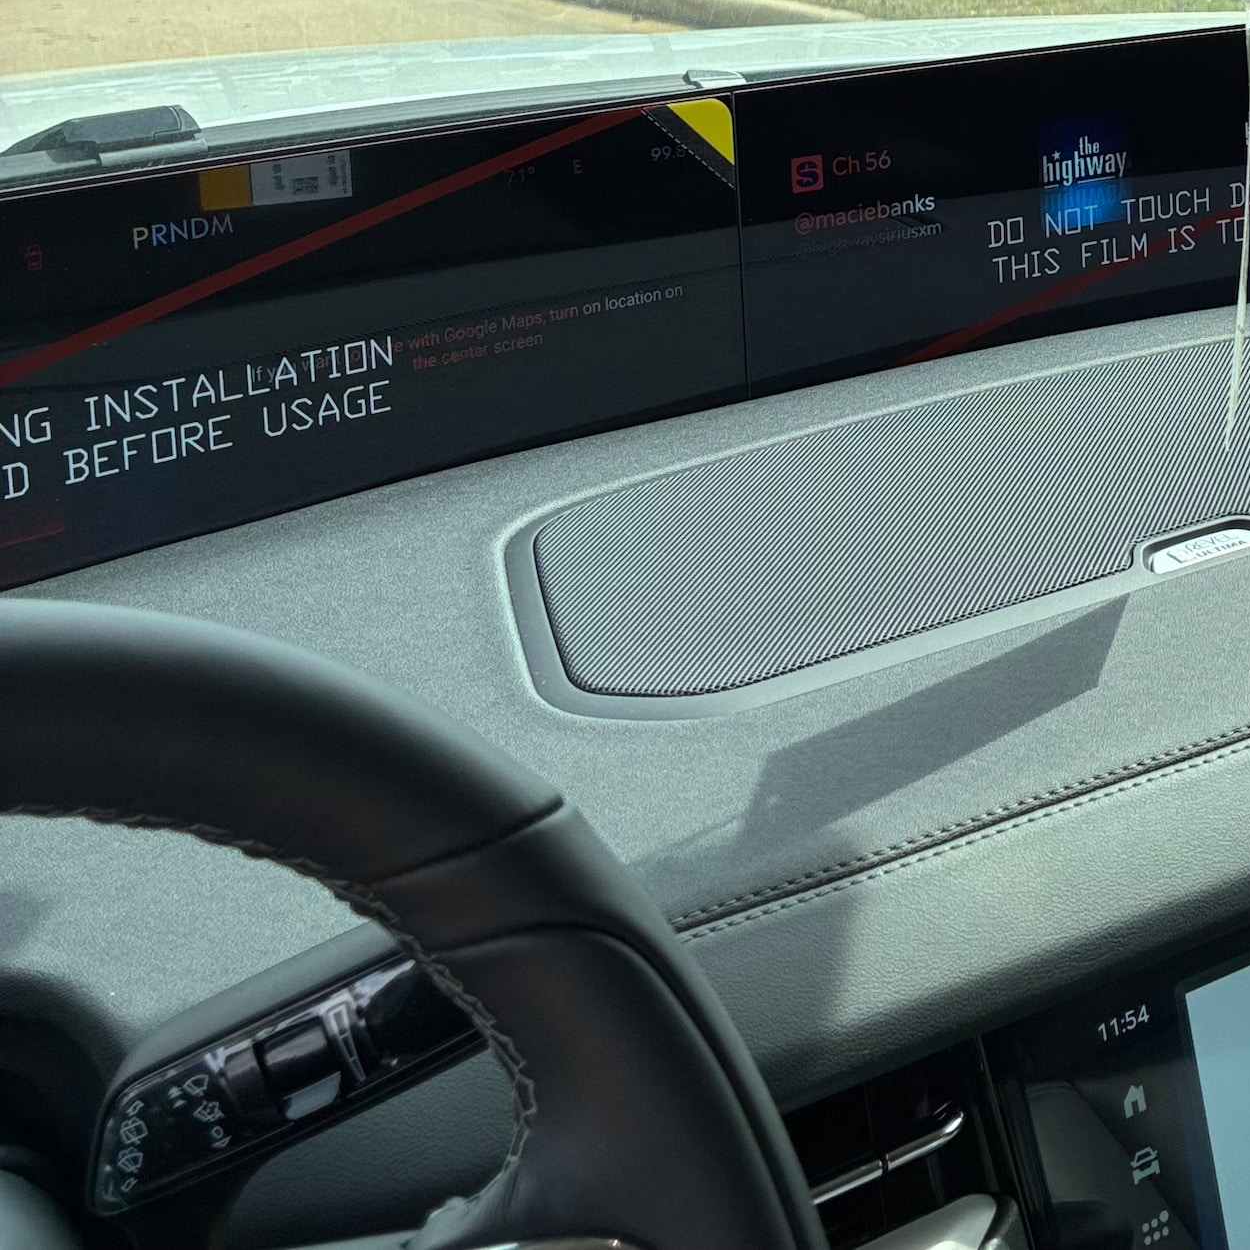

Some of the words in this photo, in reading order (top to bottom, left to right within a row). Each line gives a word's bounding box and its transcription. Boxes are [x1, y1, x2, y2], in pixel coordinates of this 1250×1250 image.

[831, 154, 861, 177] Ch
[864, 149, 892, 172] 56
[1041, 148, 1128, 187] highway
[1079, 136, 1100, 156] the
[793, 192, 937, 237] @maciebanks
[986, 215, 1025, 250] DO
[1045, 205, 1099, 240] NOT
[1120, 187, 1211, 226] TOUCH
[992, 248, 1061, 284] THIS
[1080, 232, 1150, 269] FILM
[1167, 224, 1197, 255] IS
[1216, 216, 1249, 246] TO
[406, 330, 441, 351] with
[444, 316, 499, 348] Google
[501, 310, 548, 334] Maps,
[549, 305, 580, 324] turn
[582, 299, 602, 317] on
[604, 286, 662, 312] location
[665, 282, 685, 302] on
[411, 352, 438, 372] the
[441, 343, 490, 367] center
[493, 331, 544, 354] screen
[85, 335, 394, 433] INSTALLATION
[1, 461, 30, 501] D
[63, 414, 234, 486] BEFORE
[263, 379, 393, 438] USAGE
[1097, 1003, 1150, 1042] 11:54
